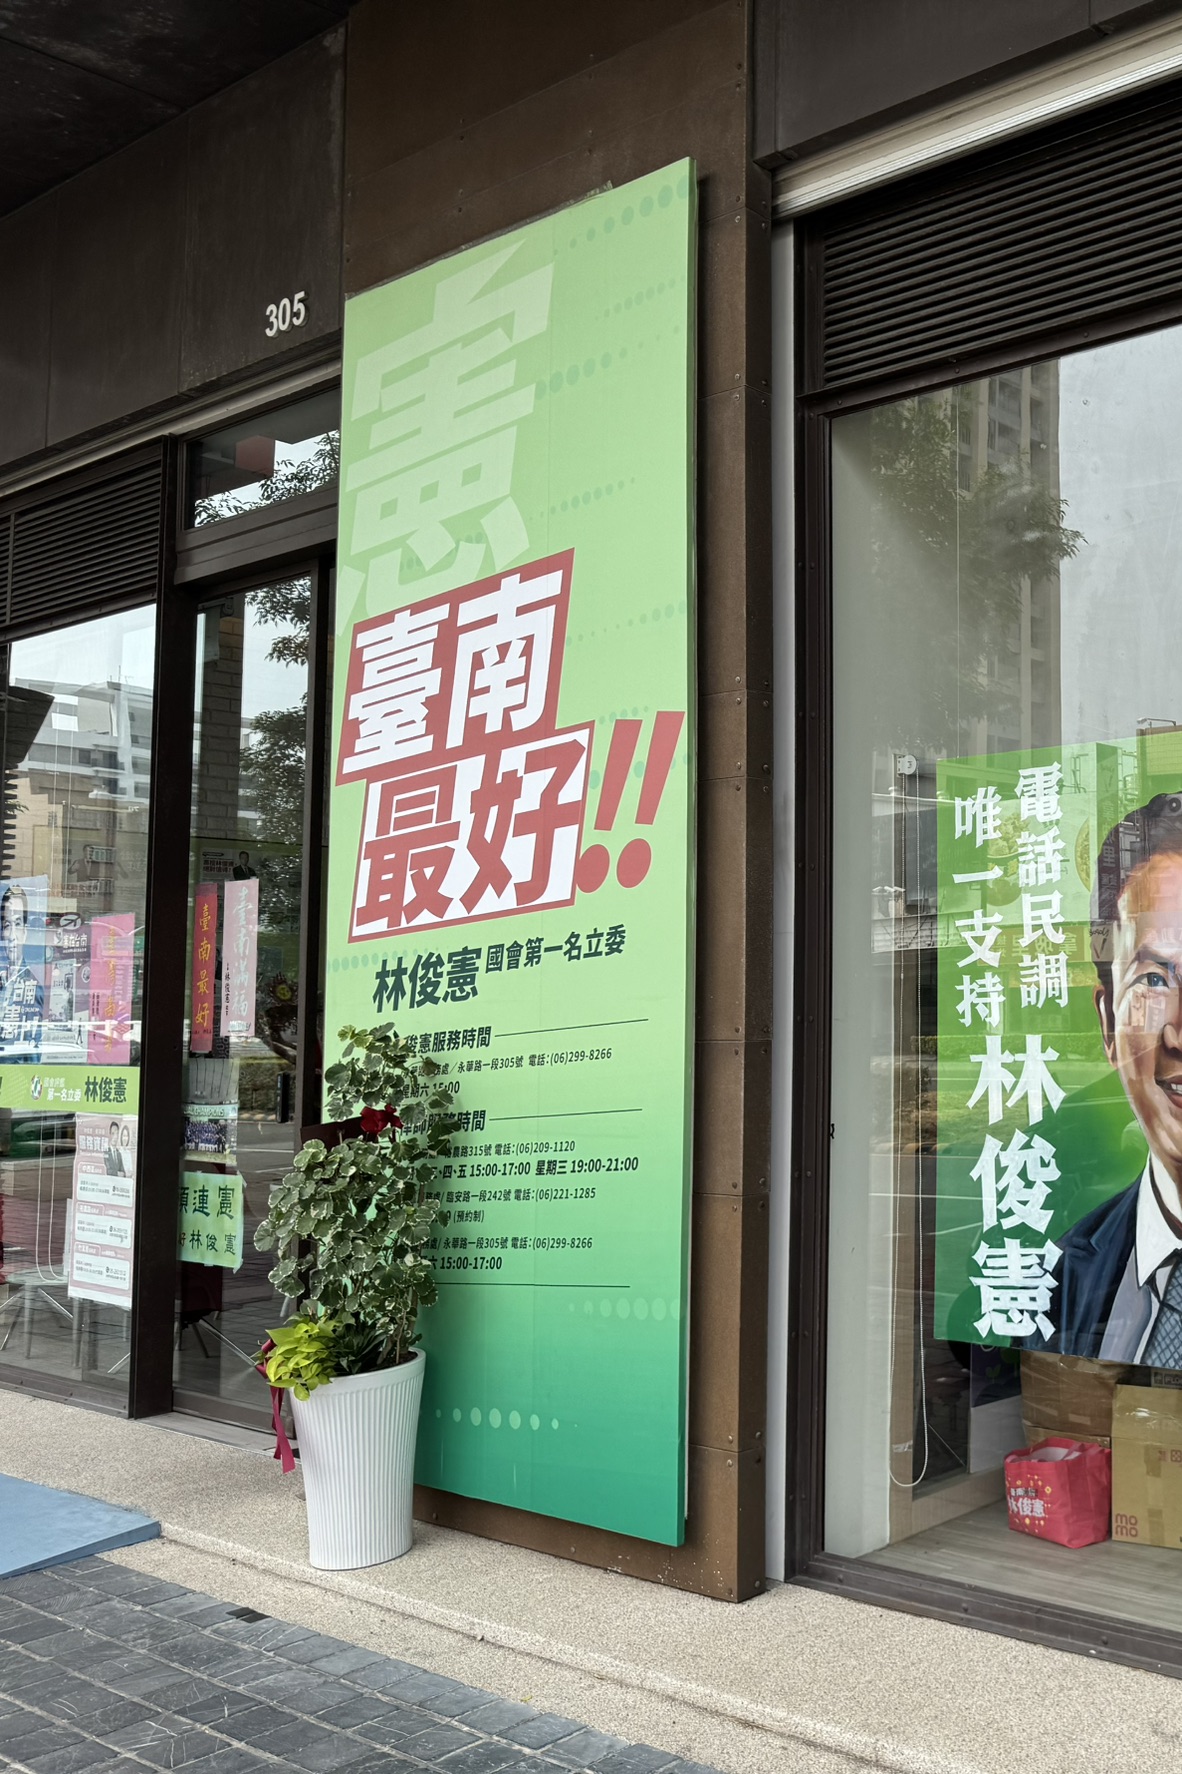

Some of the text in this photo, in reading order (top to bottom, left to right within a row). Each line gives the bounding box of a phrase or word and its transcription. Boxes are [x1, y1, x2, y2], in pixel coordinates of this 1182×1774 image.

[264, 291, 310, 338] 305
[342, 569, 563, 776] 臺南
[356, 710, 685, 928] 最好!!
[953, 785, 1007, 1028] 唯一支持
[1014, 761, 1069, 1009] 電話民調
[195, 903, 212, 1027] 臺南最好
[372, 923, 626, 1014] 林俊憲 國會第一名立委
[402, 1025, 492, 1057] 俊憲服務時間
[84, 1075, 128, 1104] 林俊憲
[469, 1161, 531, 1177] 15:00-17:00
[535, 1159, 568, 1176] 星期三
[570, 1156, 639, 1174] 19:00-21:00
[965, 1034, 1067, 1341] 林俊憲
[439, 1256, 503, 1271] 15:00-17:00
[1115, 1513, 1139, 1526] mo
[1115, 1525, 1139, 1538] mo
